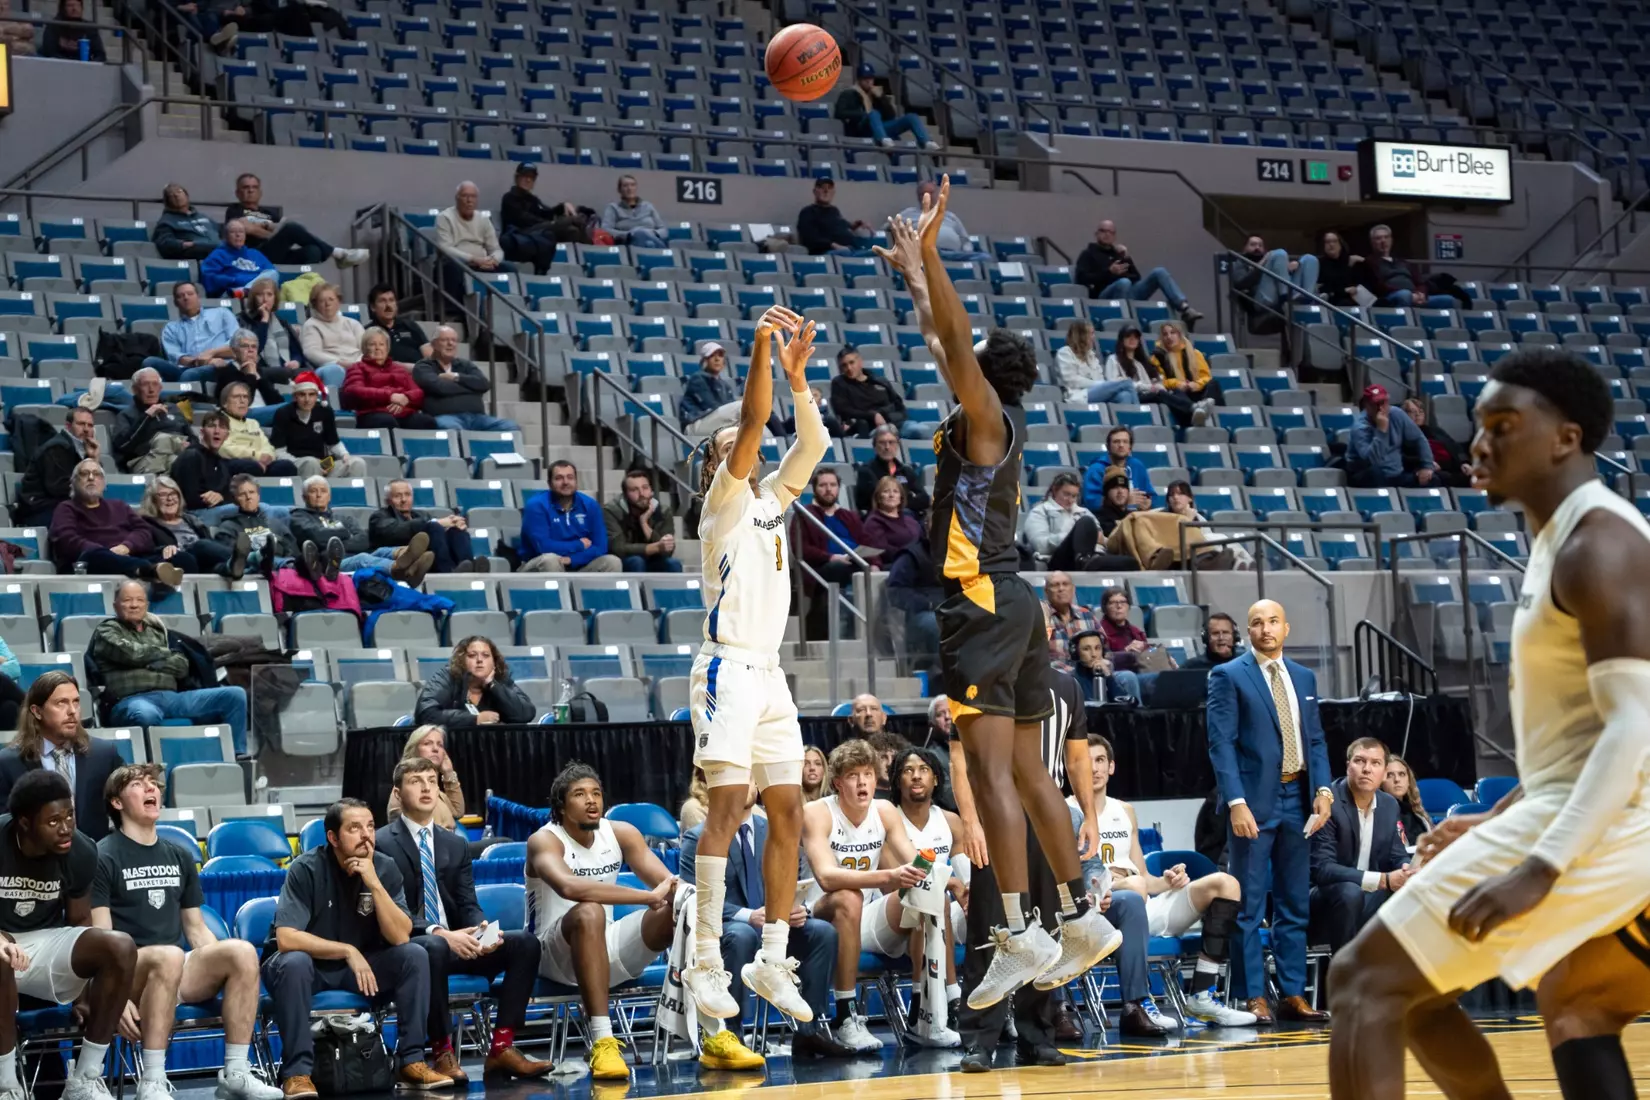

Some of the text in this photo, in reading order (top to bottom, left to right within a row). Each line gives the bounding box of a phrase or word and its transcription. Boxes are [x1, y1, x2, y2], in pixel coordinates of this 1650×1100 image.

[800, 55, 840, 87] Wilson
[1262, 161, 1290, 179] 214
[1416, 149, 1494, 176] Burt Blee
[682, 179, 717, 201] 216
[1099, 831, 1128, 839] ODONS
[122, 864, 181, 880] MASTODON
[572, 861, 620, 877] ASTODONS
[0, 876, 61, 892] MASTODON
[133, 879, 175, 888] BASKETBALL
